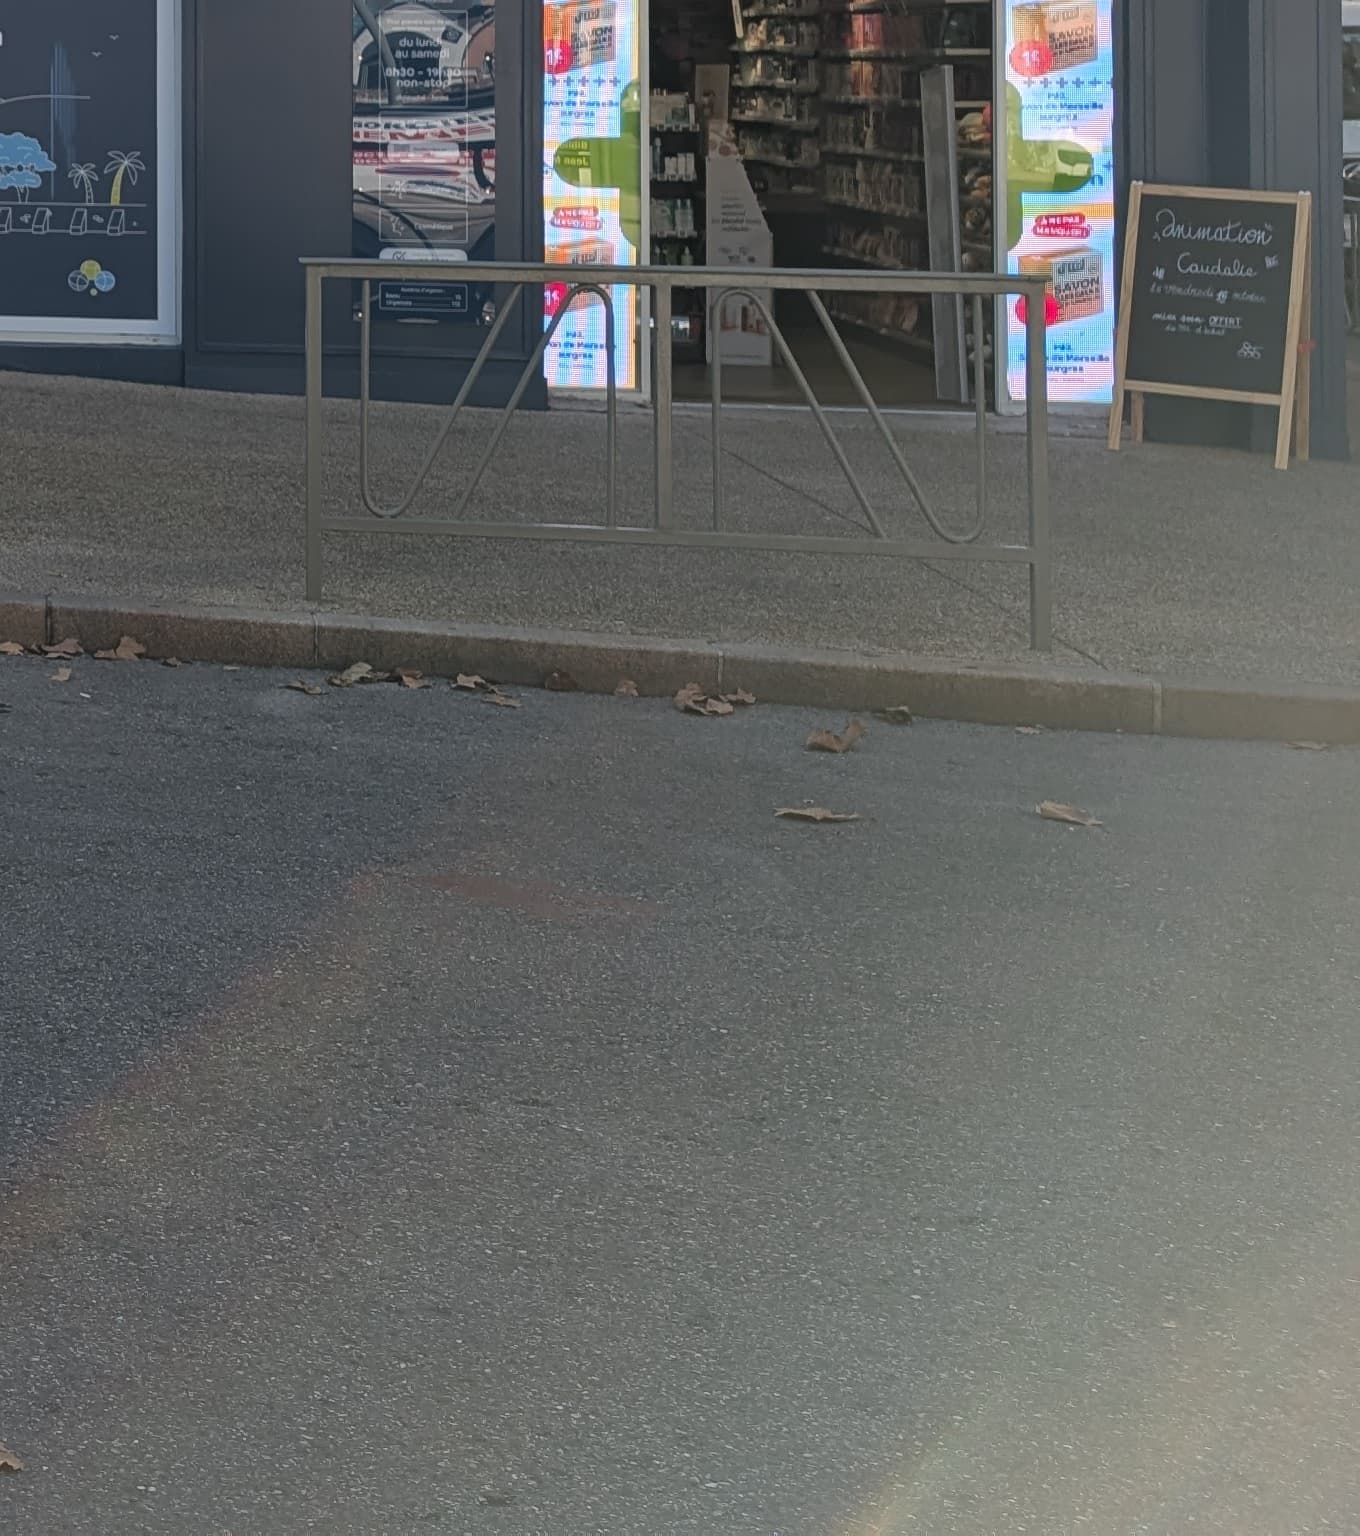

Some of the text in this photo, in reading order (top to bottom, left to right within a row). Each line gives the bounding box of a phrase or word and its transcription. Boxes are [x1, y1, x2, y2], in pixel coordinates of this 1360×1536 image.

[399, 37, 442, 48] du lundi
[395, 48, 450, 59] au samedi
[385, 67, 415, 77] 8h30
[396, 79, 450, 89] non-stop
[1177, 252, 1257, 278] Caudalie
[1055, 276, 1100, 294] SAVON
